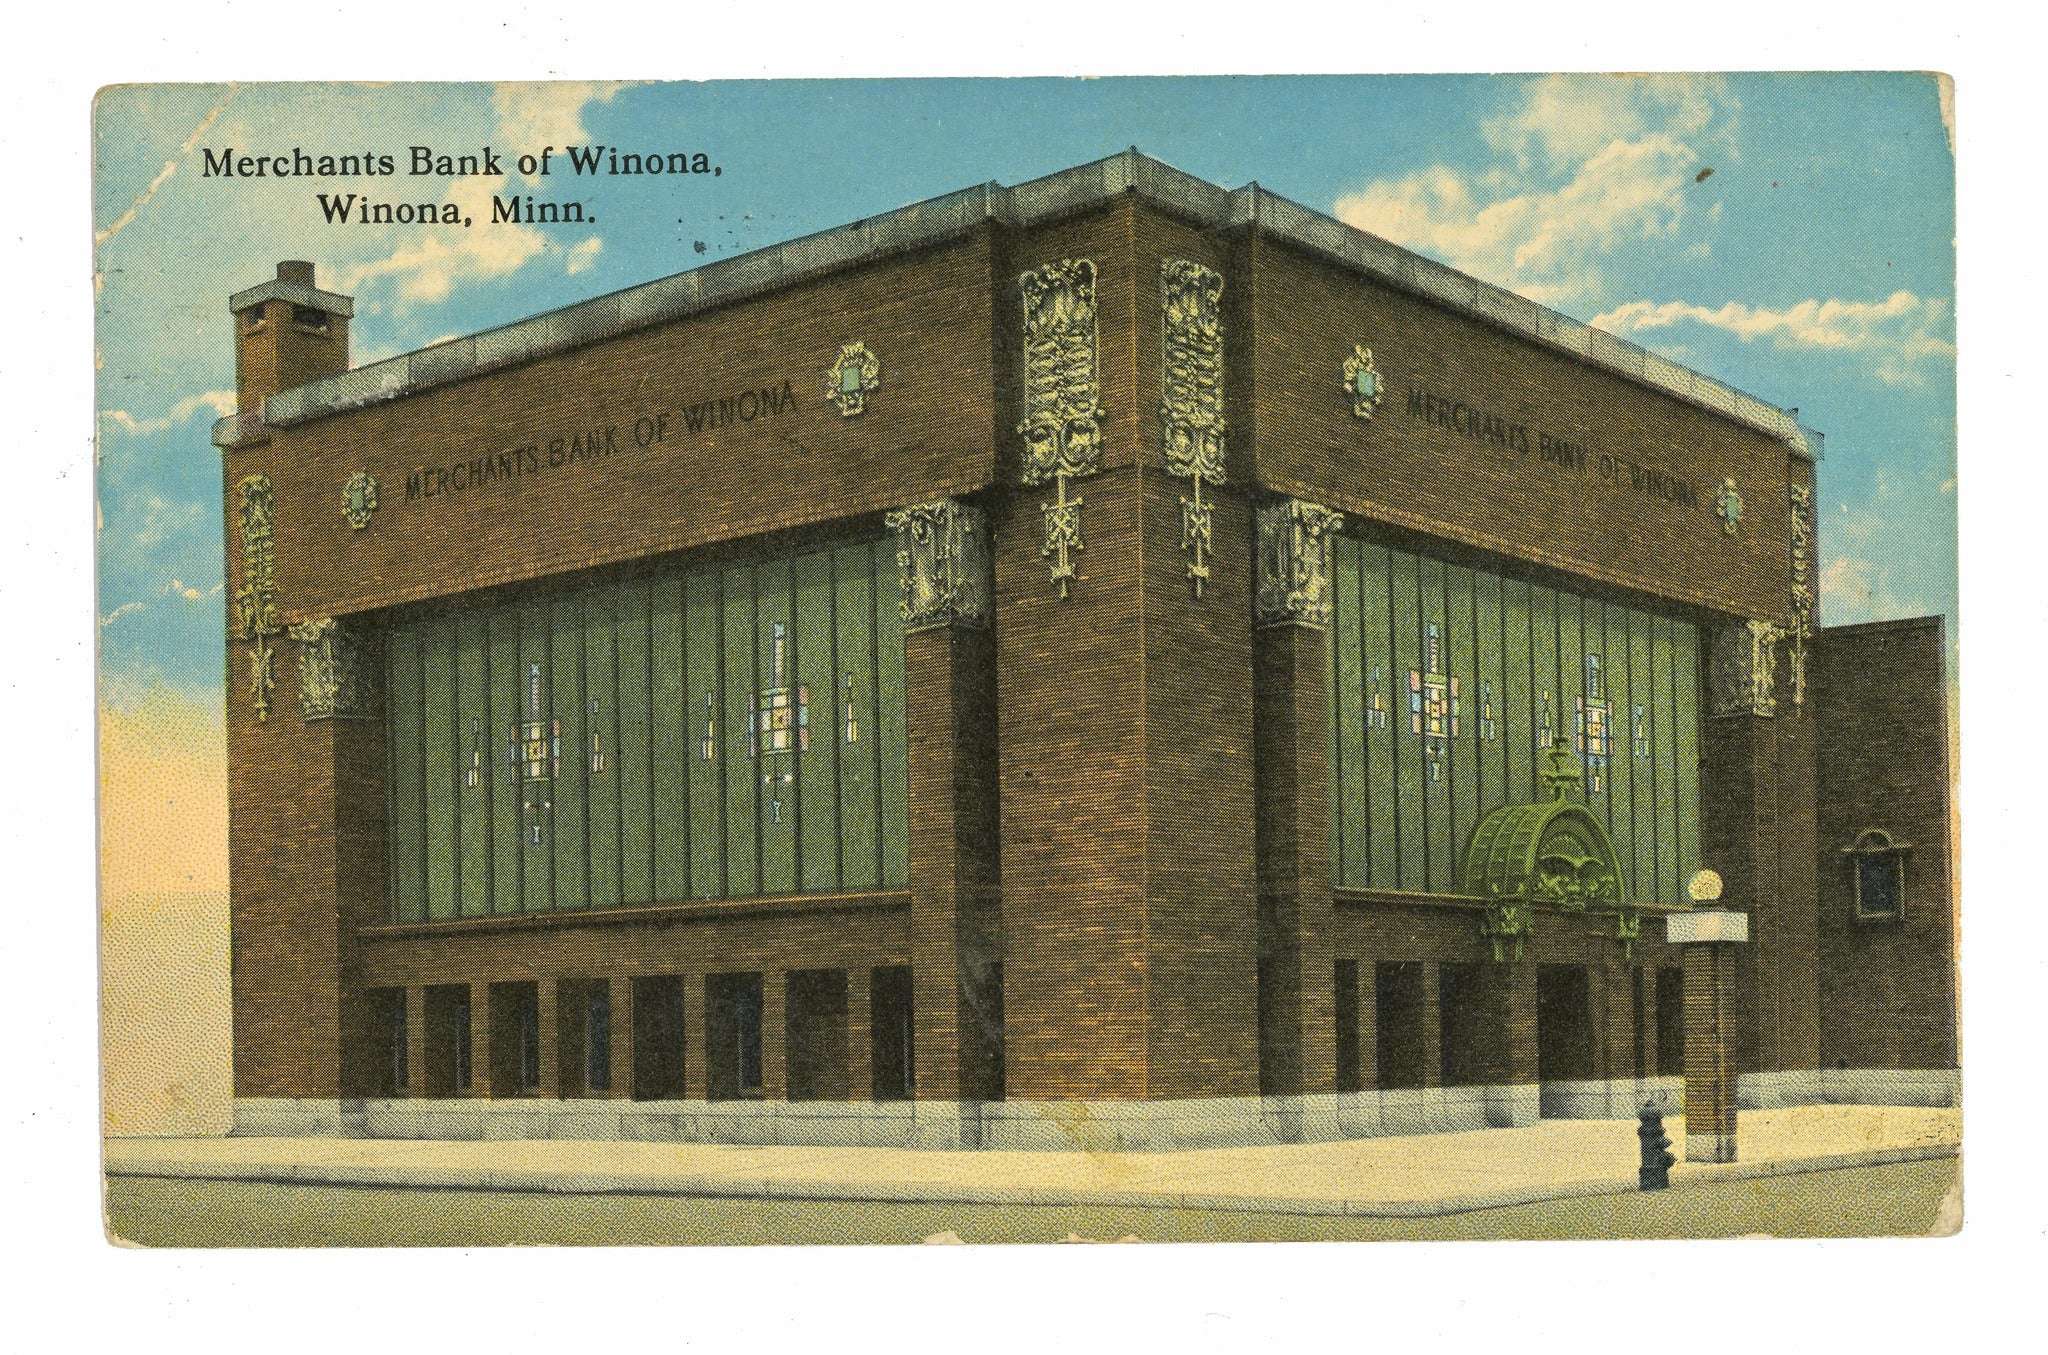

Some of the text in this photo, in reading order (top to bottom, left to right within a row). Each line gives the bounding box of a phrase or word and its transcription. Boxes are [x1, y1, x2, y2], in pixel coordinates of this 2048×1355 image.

[405, 380, 796, 502] MERCHANTS BANK OF WINONA
